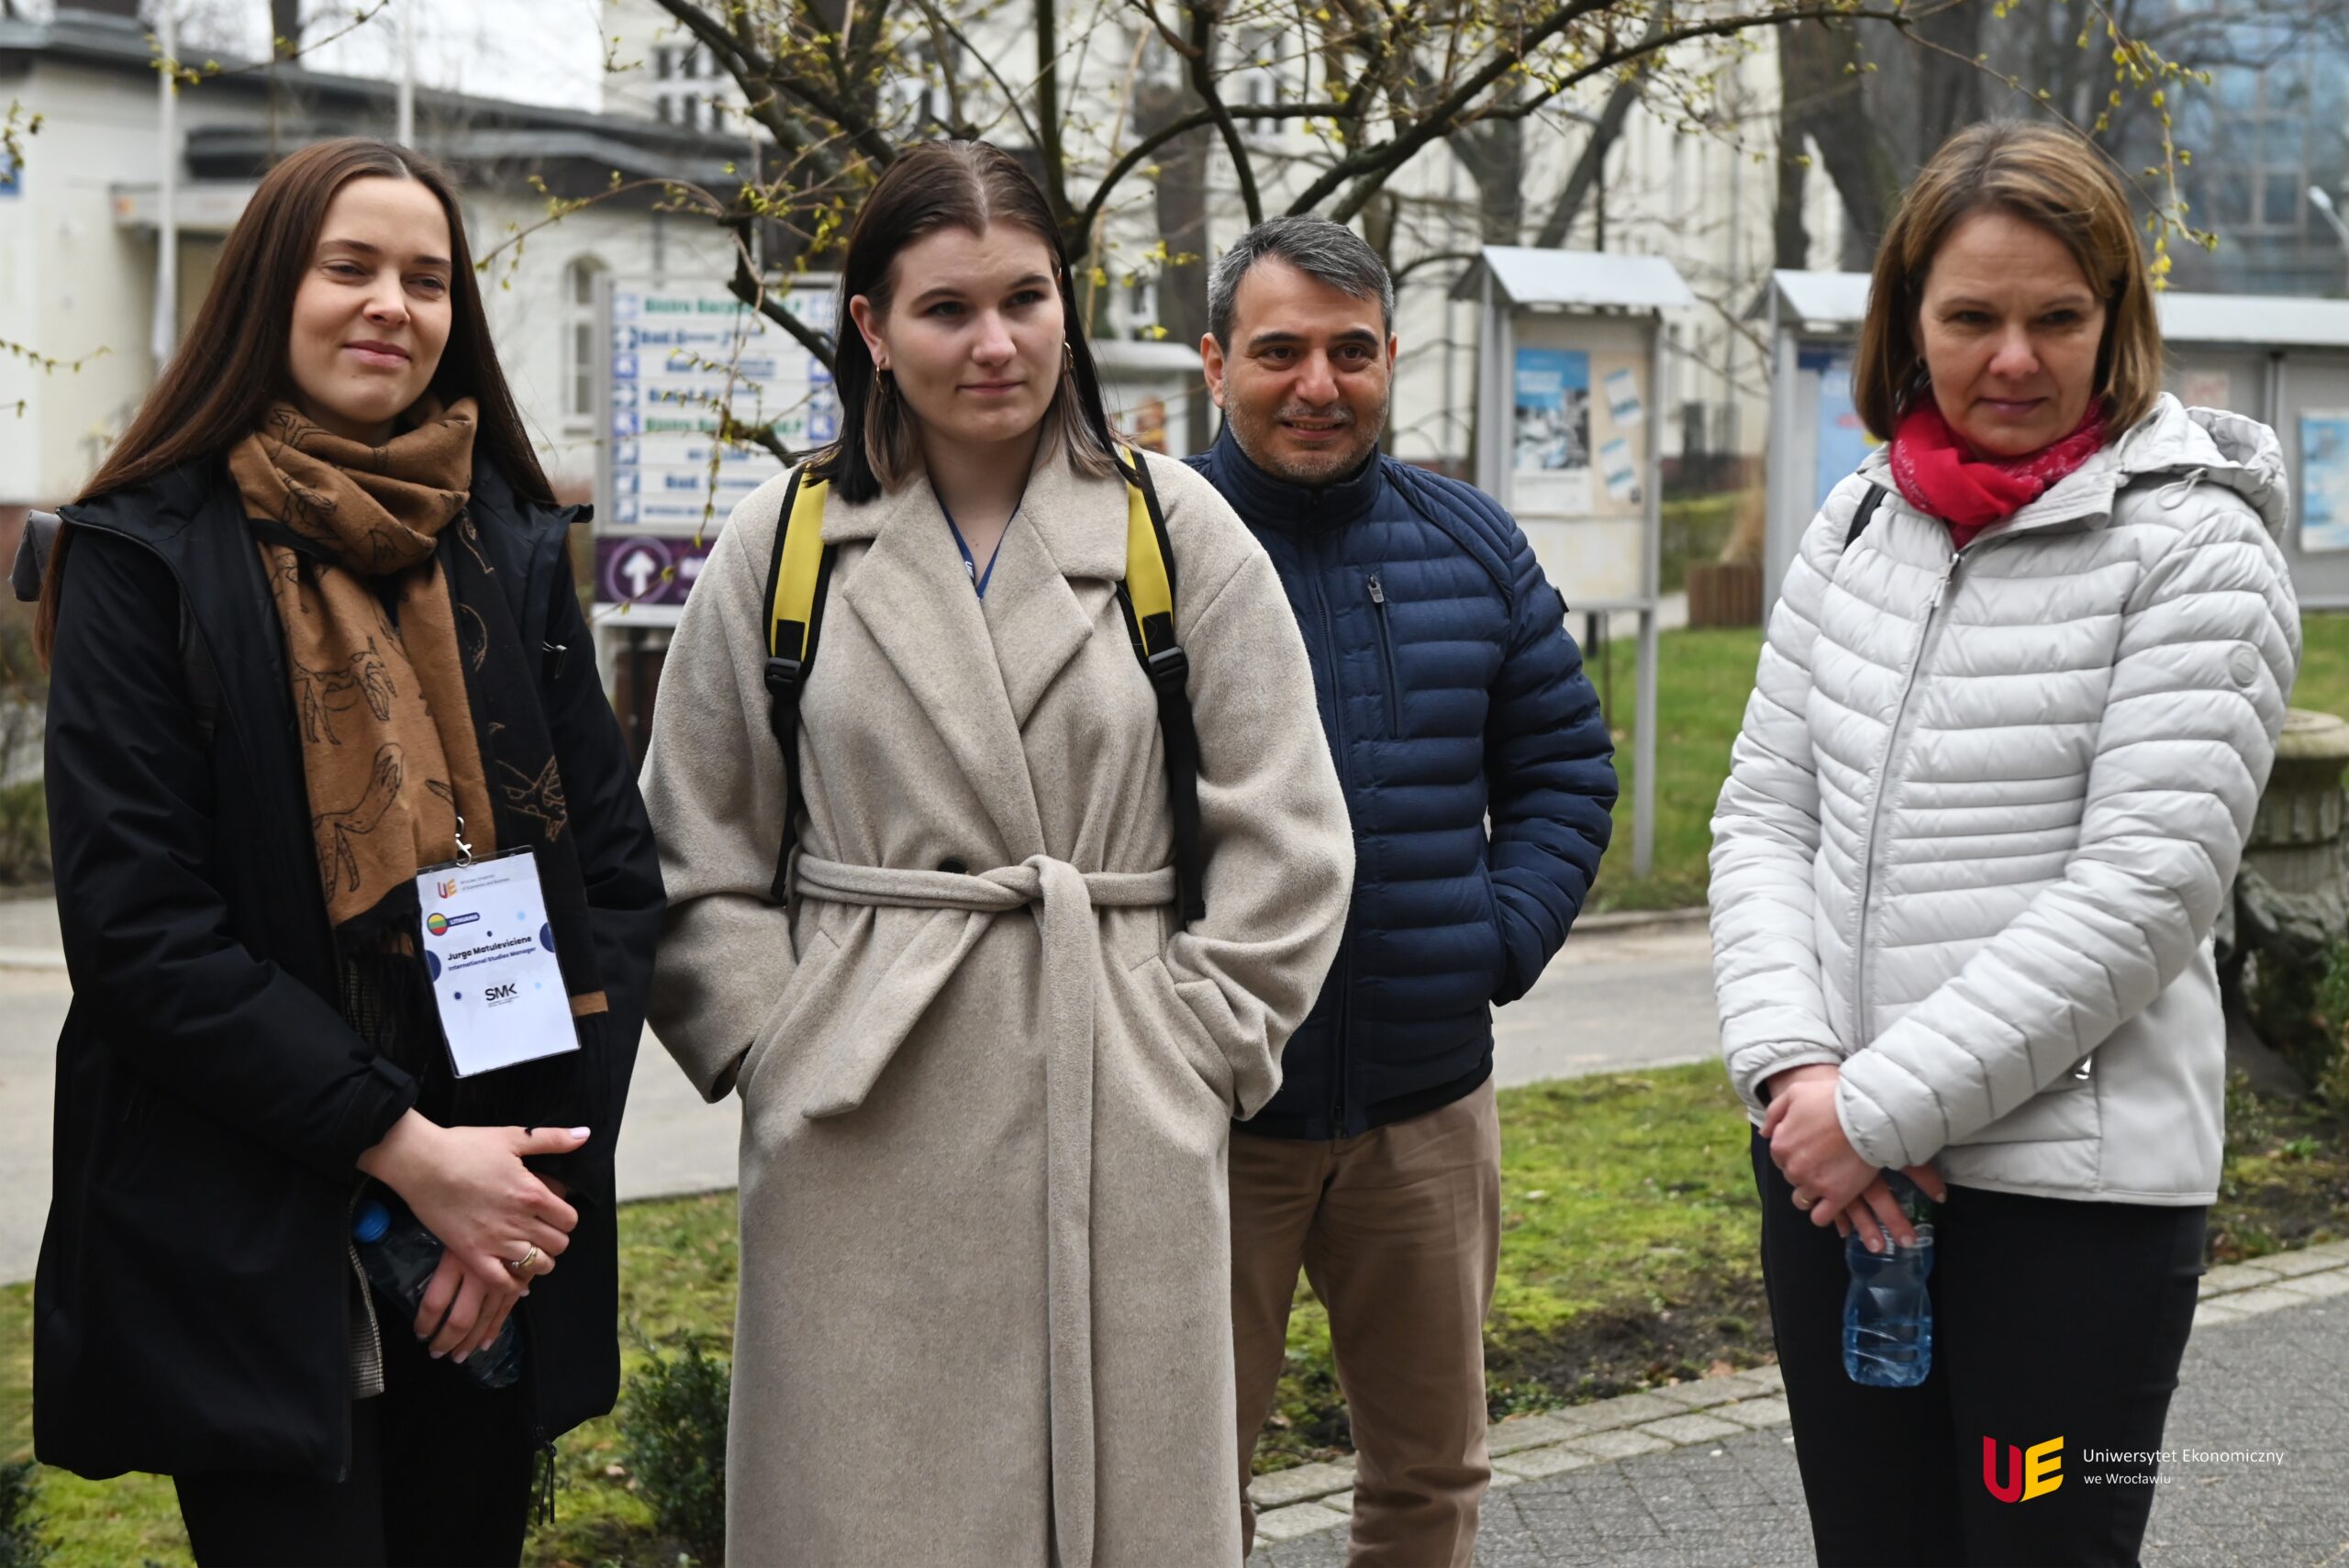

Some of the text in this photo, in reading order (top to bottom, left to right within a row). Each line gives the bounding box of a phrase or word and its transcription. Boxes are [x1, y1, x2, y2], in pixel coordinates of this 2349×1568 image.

[437, 878, 457, 899] UE
[447, 936, 532, 962] Jurga Matuleviciene
[448, 947, 537, 972] International Studies Manager
[484, 983, 518, 1001] SMK
